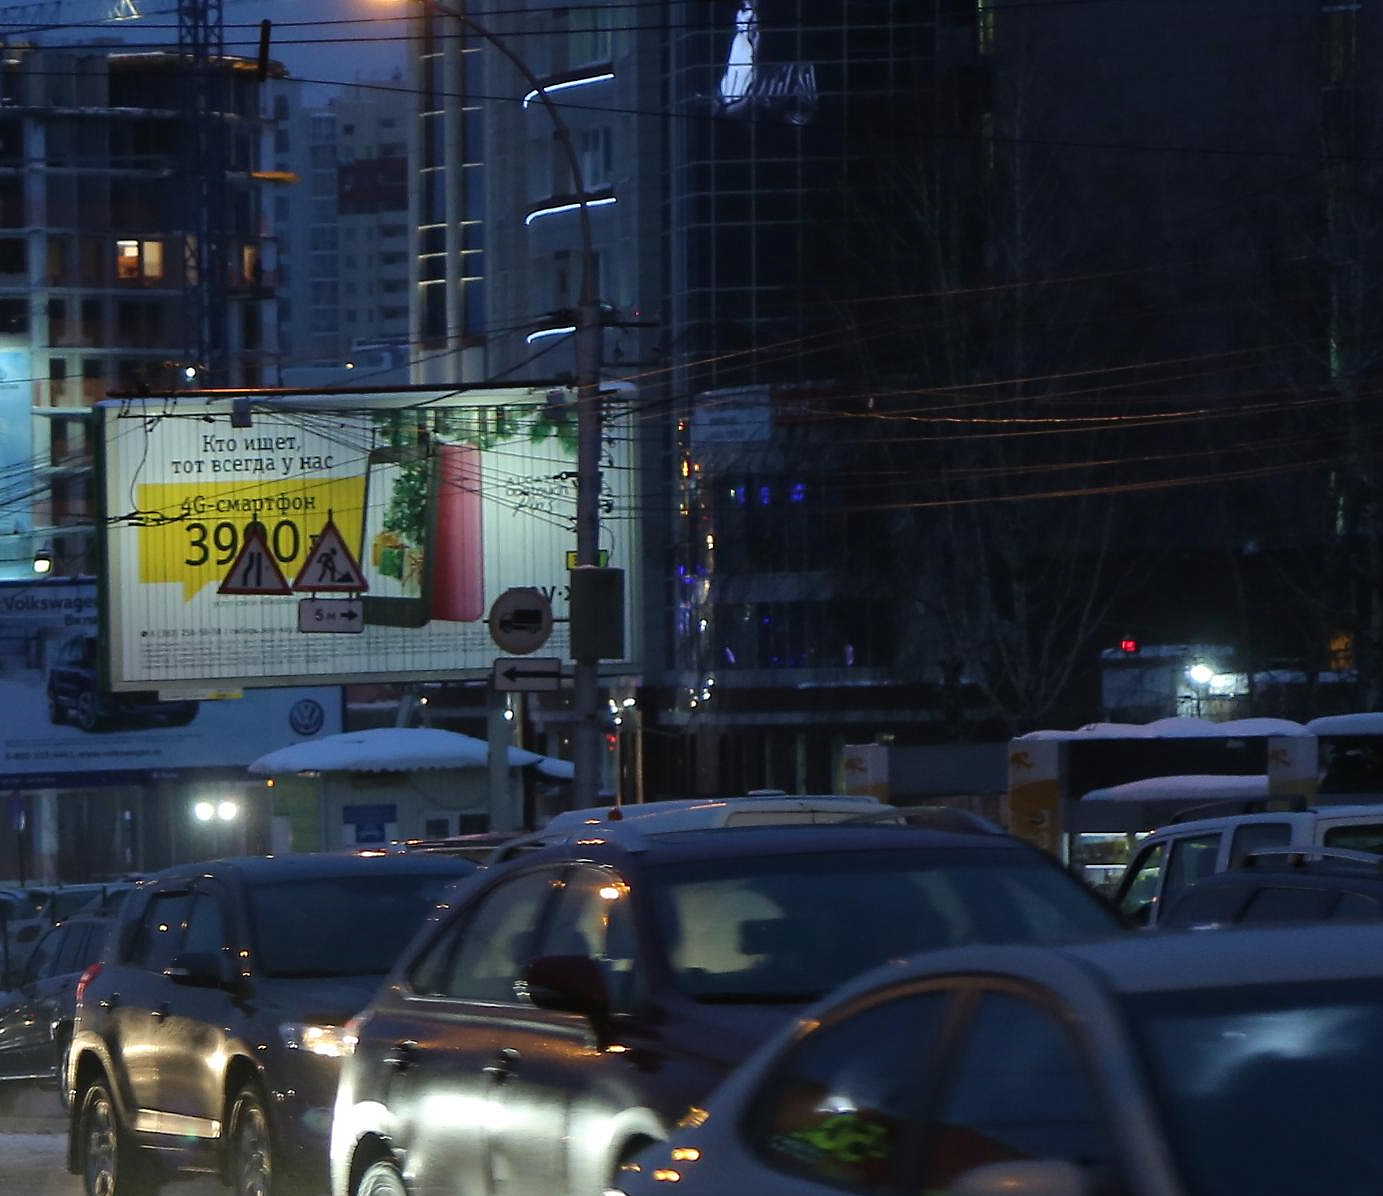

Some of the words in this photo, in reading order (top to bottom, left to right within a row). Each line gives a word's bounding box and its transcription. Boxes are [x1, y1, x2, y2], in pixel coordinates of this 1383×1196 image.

[202, 435, 237, 452] Кто
[244, 434, 302, 452] ищет,
[172, 459, 206, 474] тот
[211, 456, 276, 475] всегда
[281, 456, 295, 476] у
[299, 454, 335, 470] нас
[182, 493, 316, 516] 4G-смартфон
[3, 595, 98, 613] Volkswage
[315, 608, 324, 622] 5
